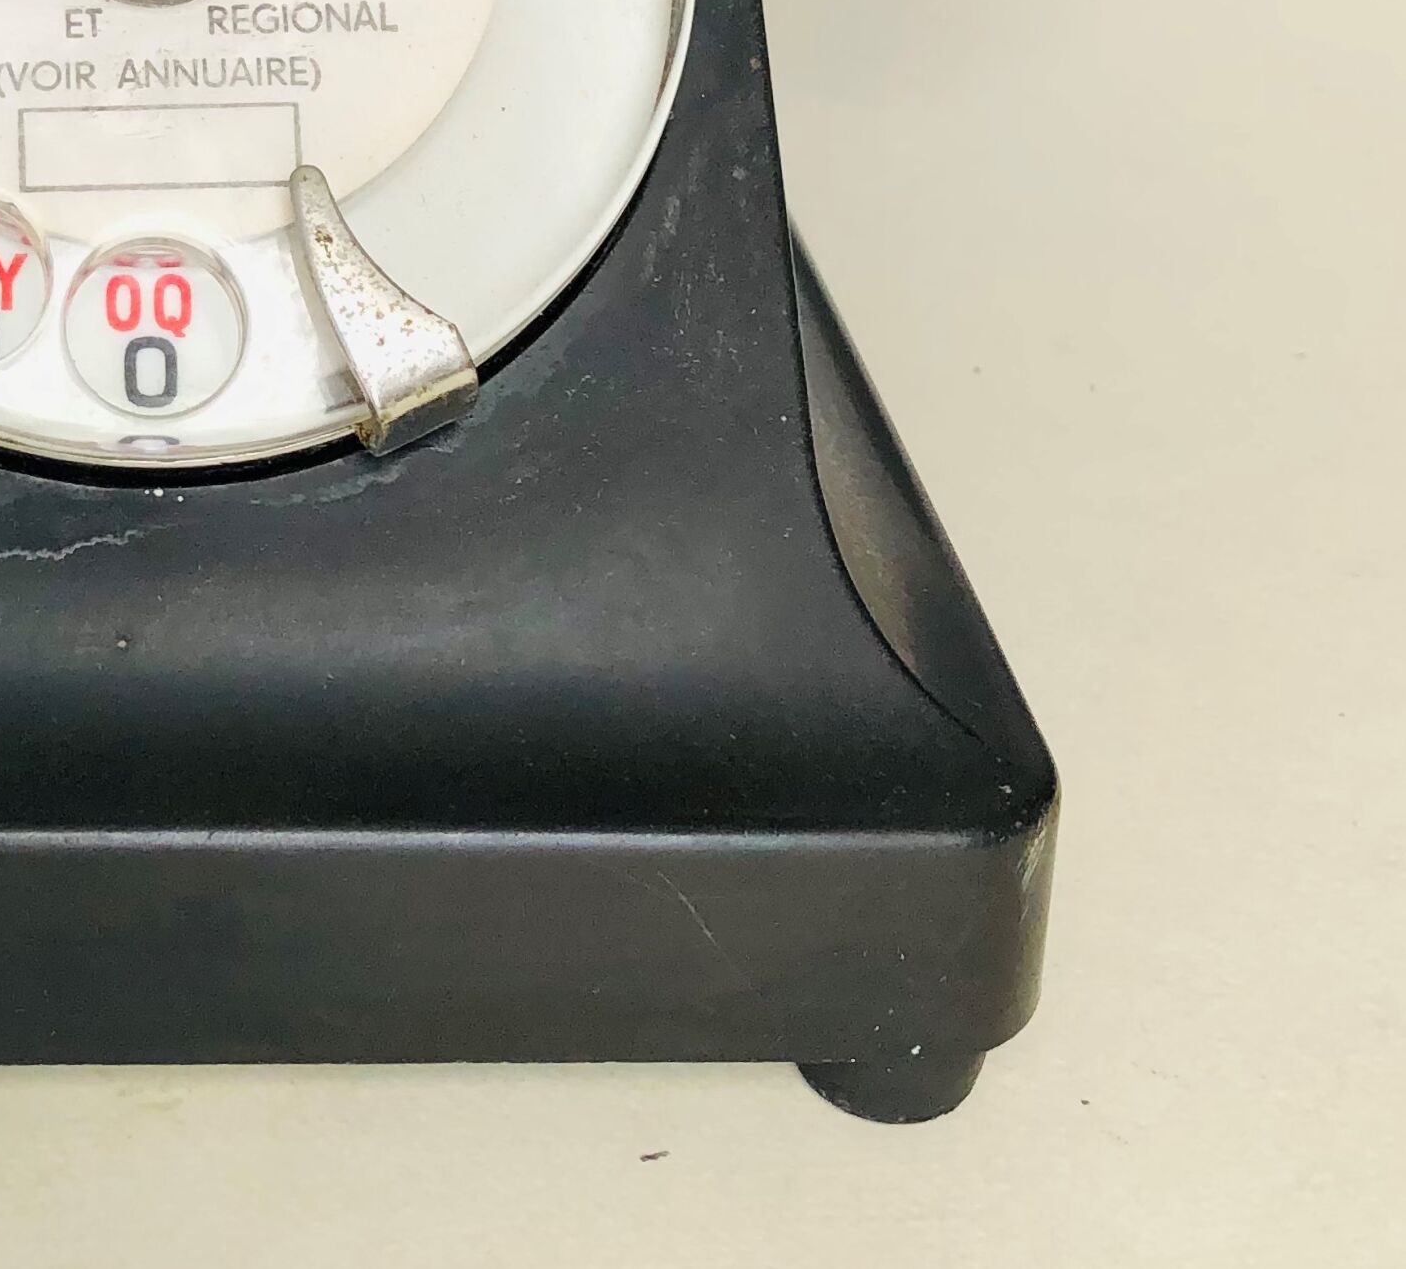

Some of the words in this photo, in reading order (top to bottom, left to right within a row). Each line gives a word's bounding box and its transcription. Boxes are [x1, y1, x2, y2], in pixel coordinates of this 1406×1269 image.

[65, 8, 102, 39] ET
[207, 1, 399, 36] REGIONAL
[117, 56, 323, 92] ANNUAIRE)
